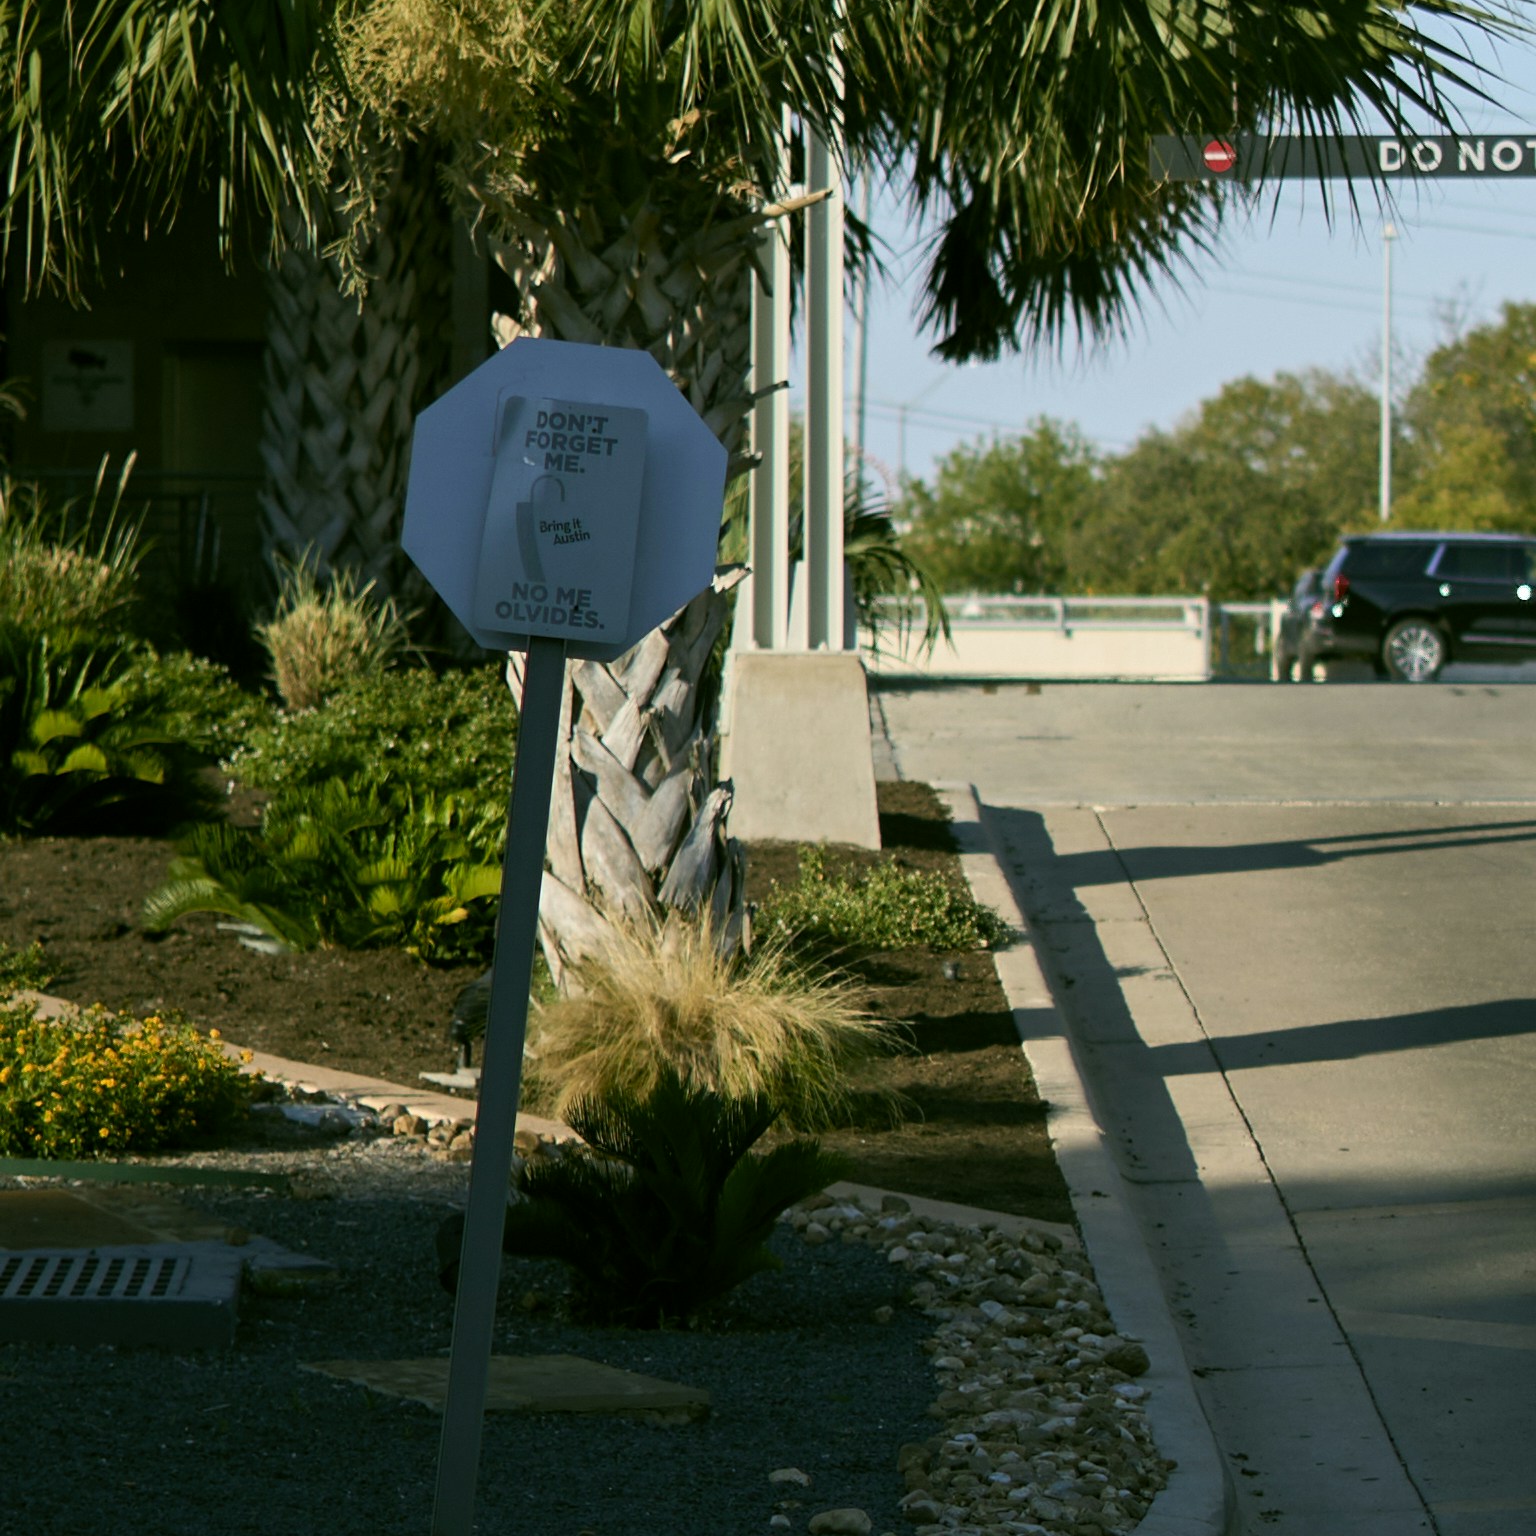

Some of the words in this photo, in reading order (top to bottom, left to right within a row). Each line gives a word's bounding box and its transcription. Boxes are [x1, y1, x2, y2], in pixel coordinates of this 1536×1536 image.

[1378, 139, 1443, 172] DO
[536, 410, 609, 434] DON'T
[524, 430, 619, 456] FORGET
[543, 452, 586, 474] ME.
[539, 520, 572, 534] Bring
[553, 530, 591, 546] Austin
[511, 581, 549, 603] NO
[555, 586, 592, 608] ME
[494, 601, 605, 630] OLVIDES.
